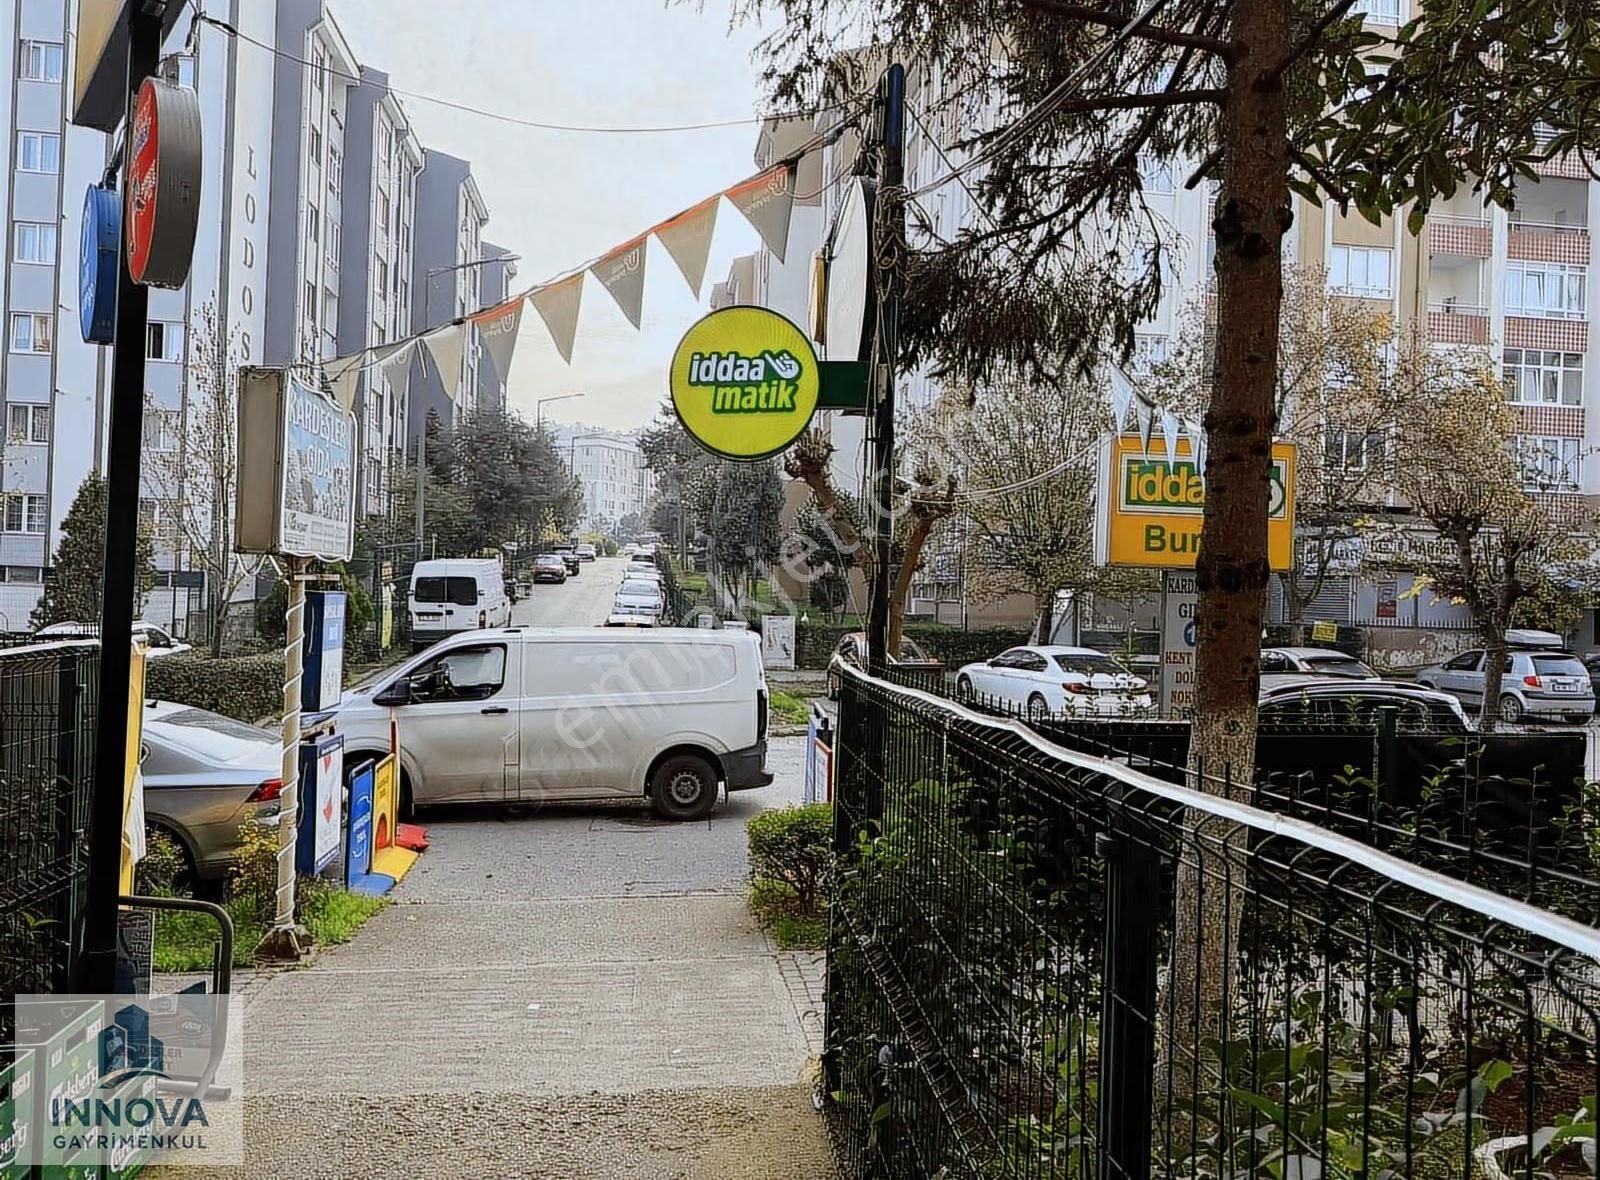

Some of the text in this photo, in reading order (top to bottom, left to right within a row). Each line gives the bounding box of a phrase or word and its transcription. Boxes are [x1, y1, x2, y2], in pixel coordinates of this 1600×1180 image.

[241, 145, 257, 361] LODOS
[689, 353, 766, 383] iddaa
[714, 382, 795, 411] matik
[1130, 463, 1206, 504] idda
[1167, 577, 1199, 594] KARD
[1165, 651, 1193, 665] KENT
[1170, 689, 1194, 704] NOK
